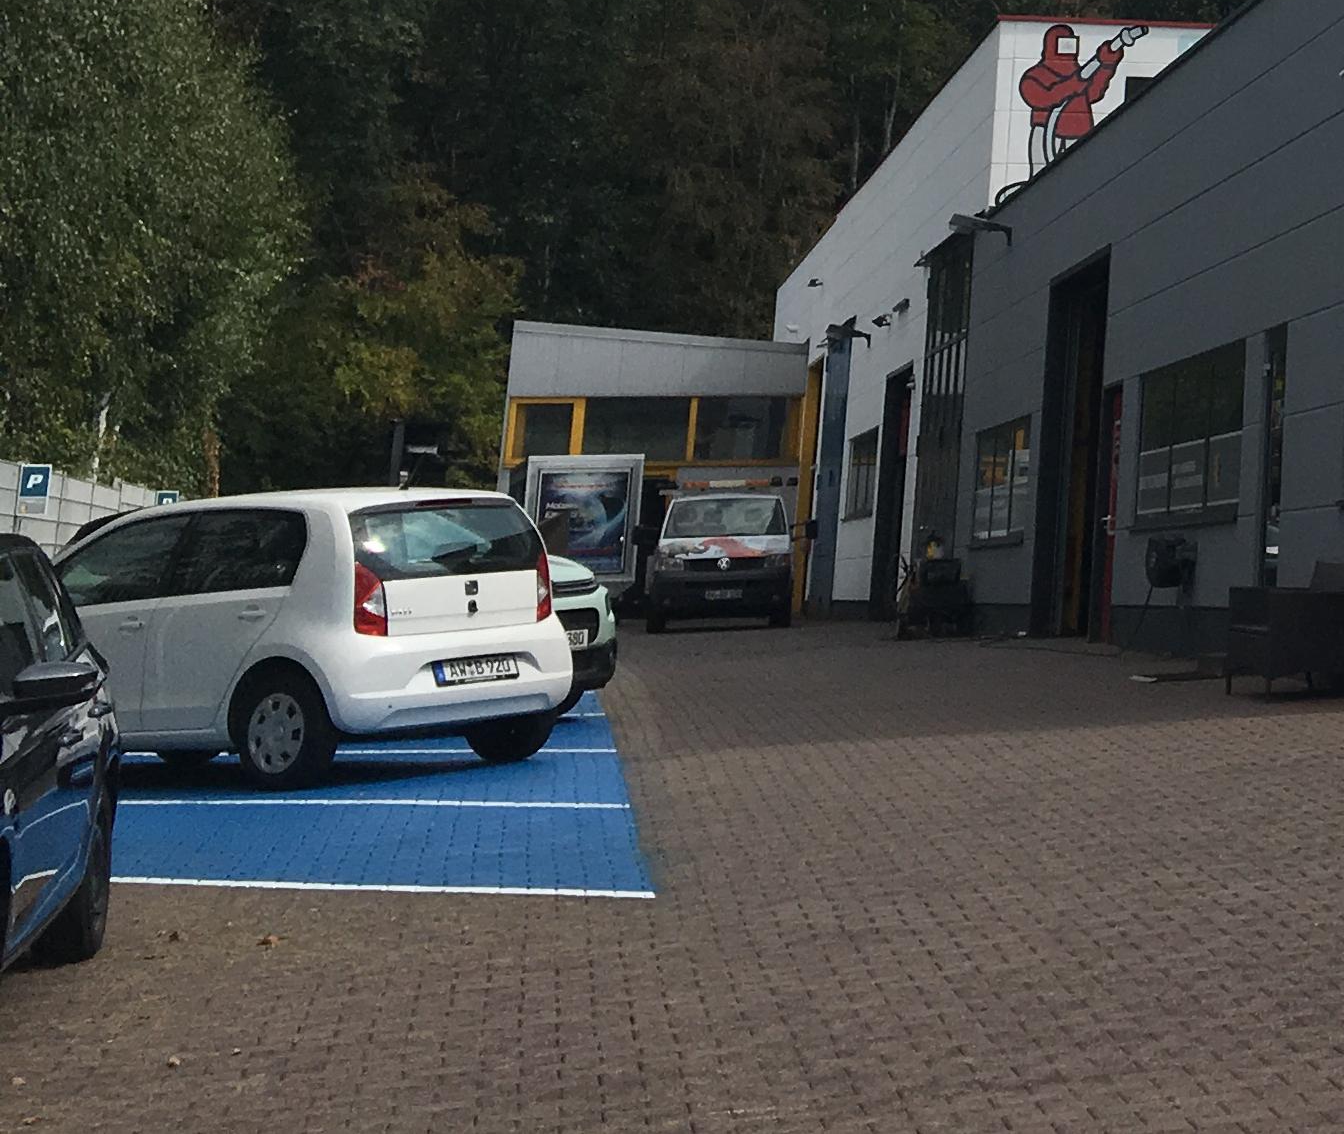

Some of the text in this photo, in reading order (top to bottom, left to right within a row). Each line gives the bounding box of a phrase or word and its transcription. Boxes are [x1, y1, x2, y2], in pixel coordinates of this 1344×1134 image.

[26, 474, 43, 489] P
[450, 661, 467, 678] AW
[486, 658, 511, 675] 920
